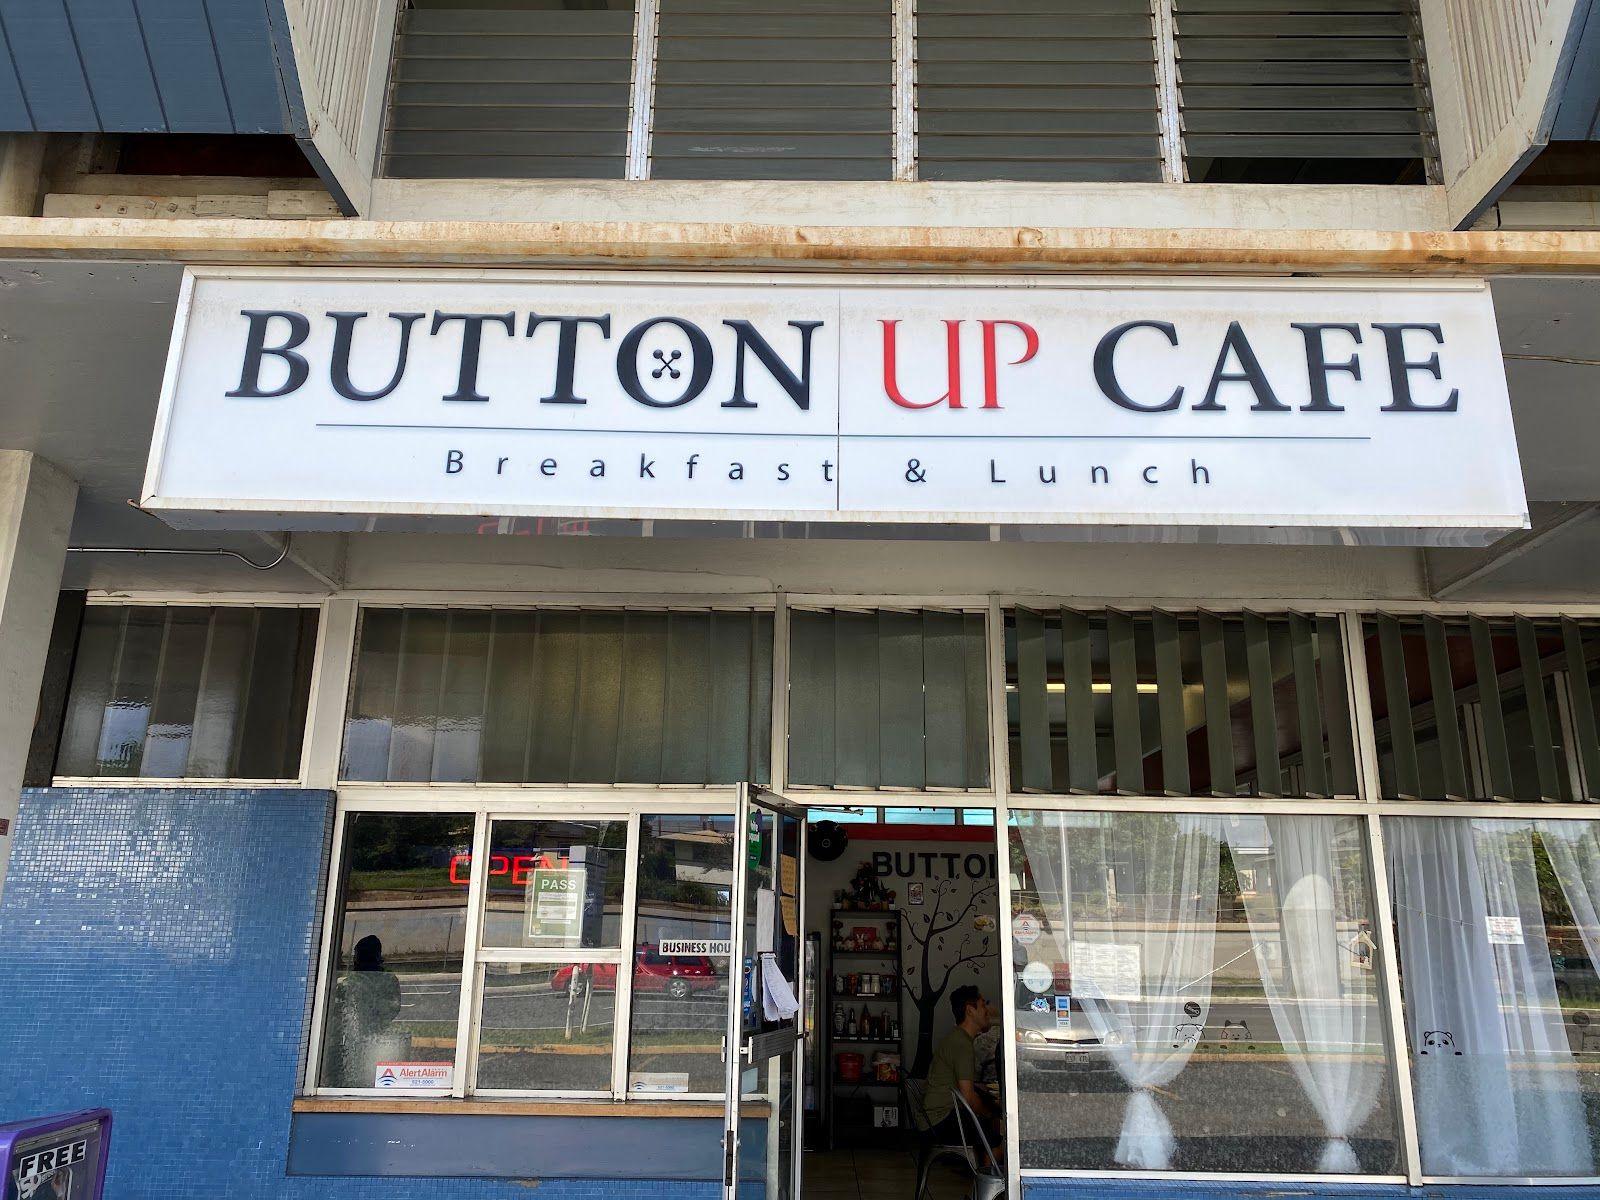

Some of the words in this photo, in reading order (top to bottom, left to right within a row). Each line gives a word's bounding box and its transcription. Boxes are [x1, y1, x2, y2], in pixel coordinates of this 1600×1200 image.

[225, 310, 825, 411] BUTTON
[878, 319, 1038, 410] UP
[1093, 320, 1459, 413] CAFE
[446, 449, 839, 483] Breakfast
[906, 458, 926, 482] &
[991, 458, 1210, 485] Lunch
[541, 879, 577, 890] PASS
[662, 942, 707, 953] BUSINESS
[399, 1068, 448, 1078] AlertAlarm
[20, 1140, 86, 1179] FREE
